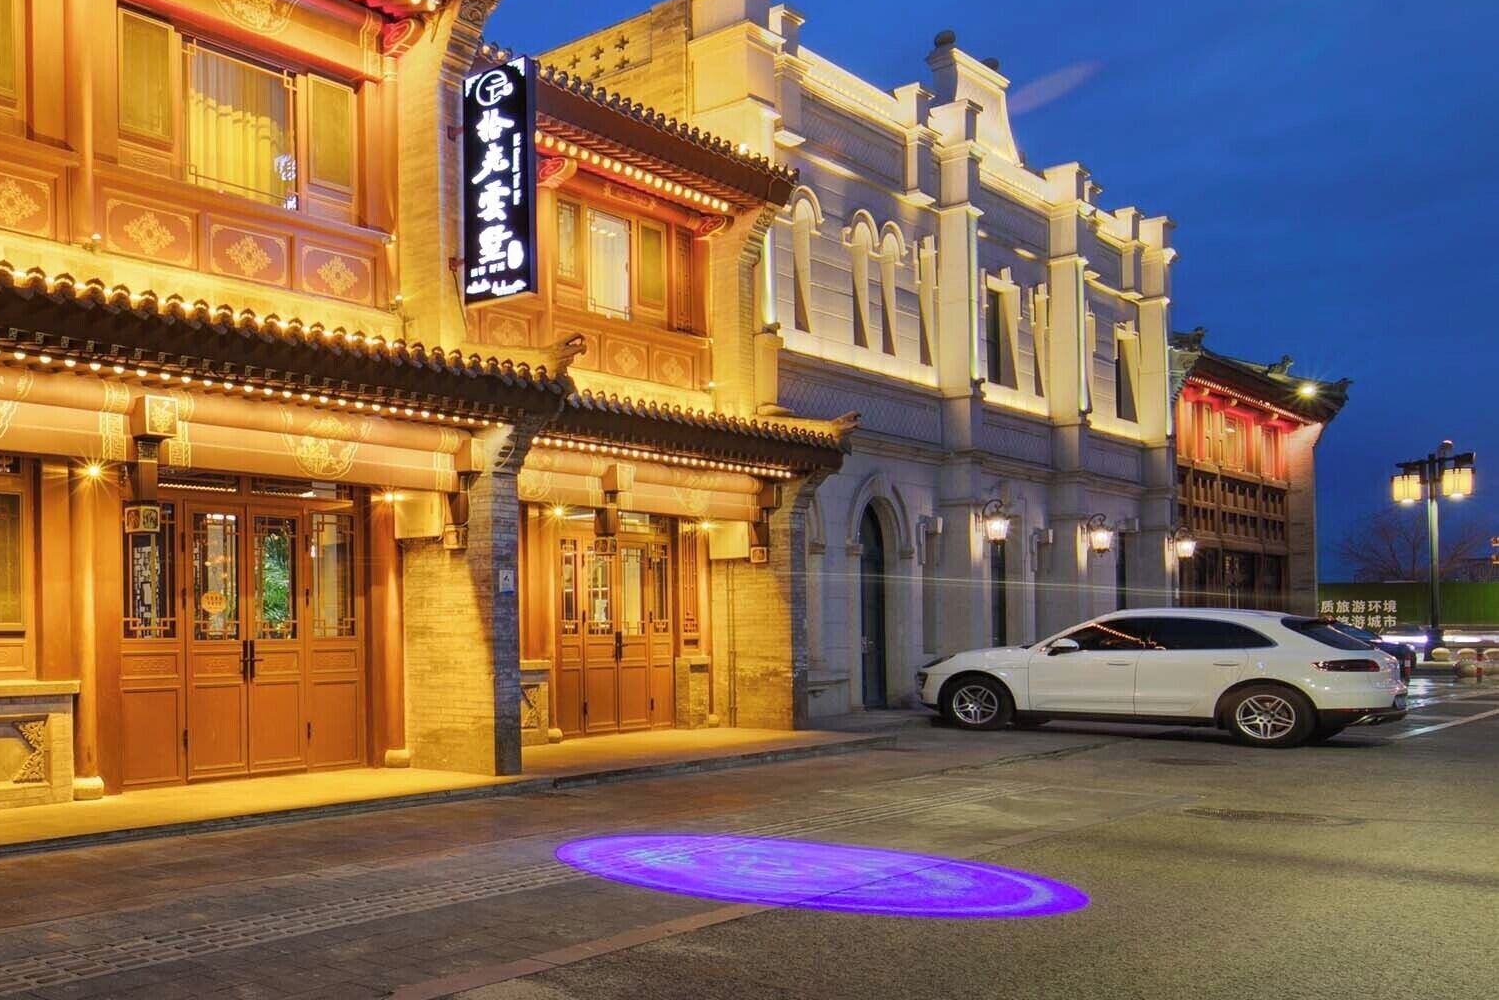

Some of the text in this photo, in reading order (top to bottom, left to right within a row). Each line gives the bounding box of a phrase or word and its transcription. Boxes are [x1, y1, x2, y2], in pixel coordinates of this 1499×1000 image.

[1317, 600, 1397, 613] 质旅游环境
